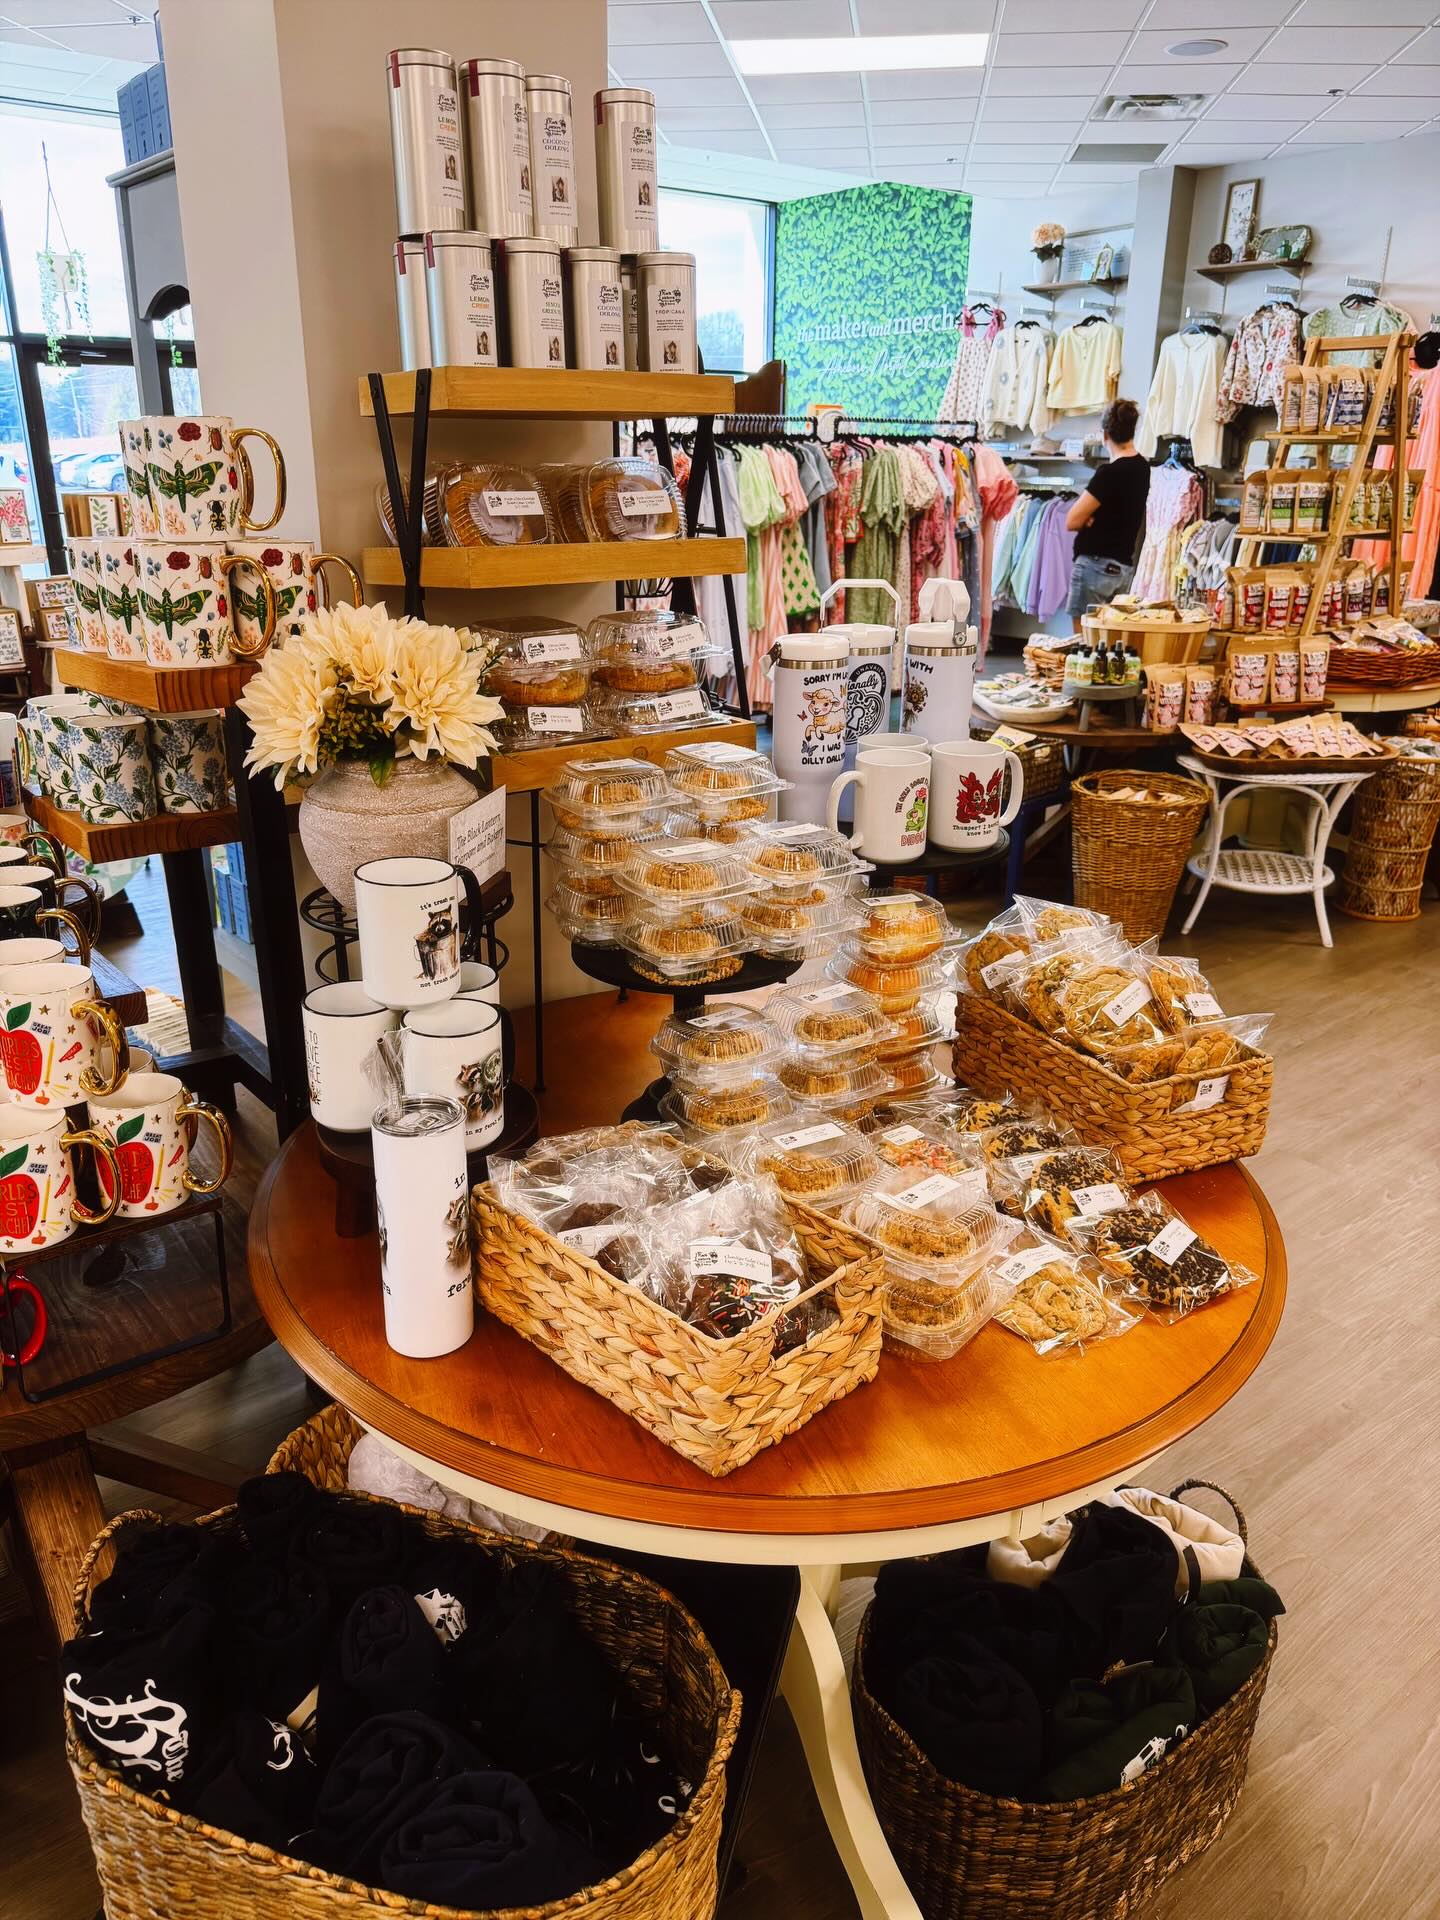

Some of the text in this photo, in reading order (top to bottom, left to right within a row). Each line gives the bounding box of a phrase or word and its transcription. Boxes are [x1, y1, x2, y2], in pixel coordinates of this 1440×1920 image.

[797, 303, 956, 343] the maker and merch
[910, 659, 934, 675] WITH
[803, 673, 831, 686] SORRY
[832, 671, 842, 681] I'M
[827, 741, 842, 753] WAS
[802, 756, 825, 765] DILLY
[456, 836, 467, 850] The
[467, 822, 481, 843] Black
[32, 1021, 52, 1030] GREAT
[145, 1132, 162, 1140] GREAT
